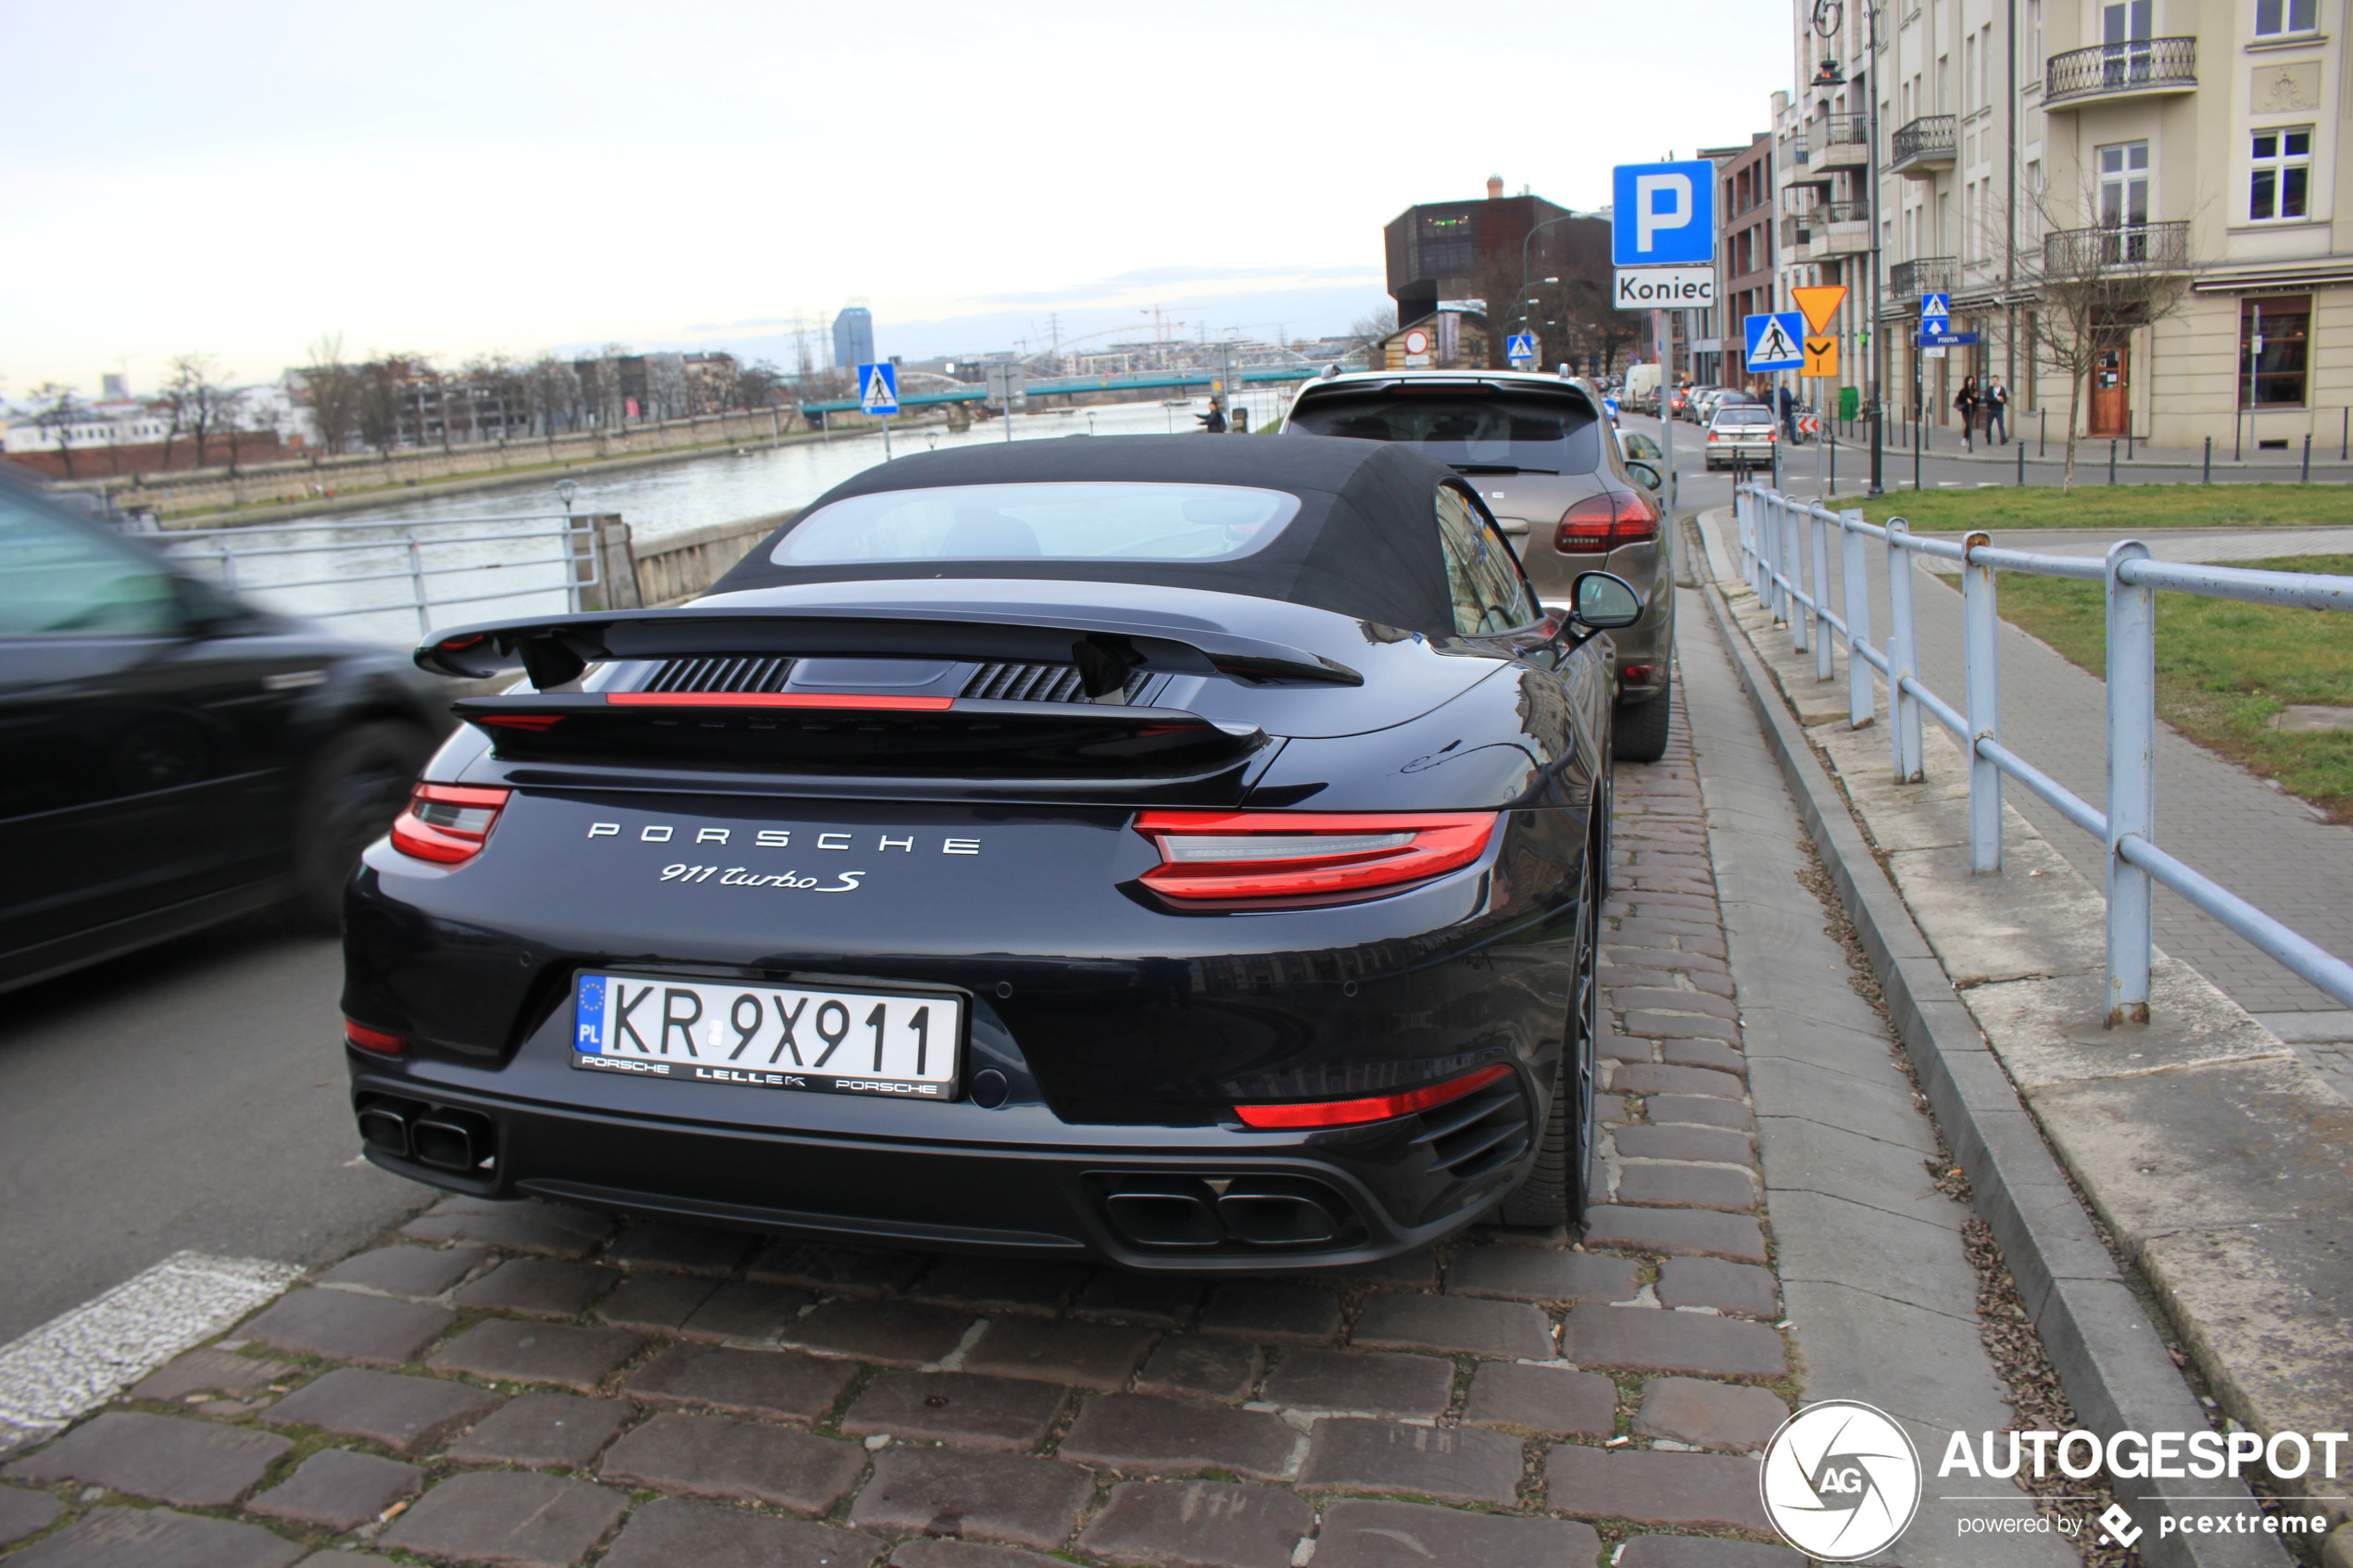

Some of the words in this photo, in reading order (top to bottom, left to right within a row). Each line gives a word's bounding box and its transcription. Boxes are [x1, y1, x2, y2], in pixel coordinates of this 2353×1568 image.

[1637, 173, 1692, 252] P
[1619, 277, 1712, 300] Koniec
[587, 822, 982, 855] PORSCHE
[661, 863, 720, 883] 911
[719, 867, 818, 890] turbo
[814, 871, 866, 893] S
[579, 1024, 599, 1044] PL
[613, 985, 703, 1057] KR
[728, 994, 930, 1075] 9X911
[582, 1056, 670, 1074] PORSCHE
[696, 1068, 806, 1086] LELLEK
[836, 1079, 937, 1095] PORSCHE
